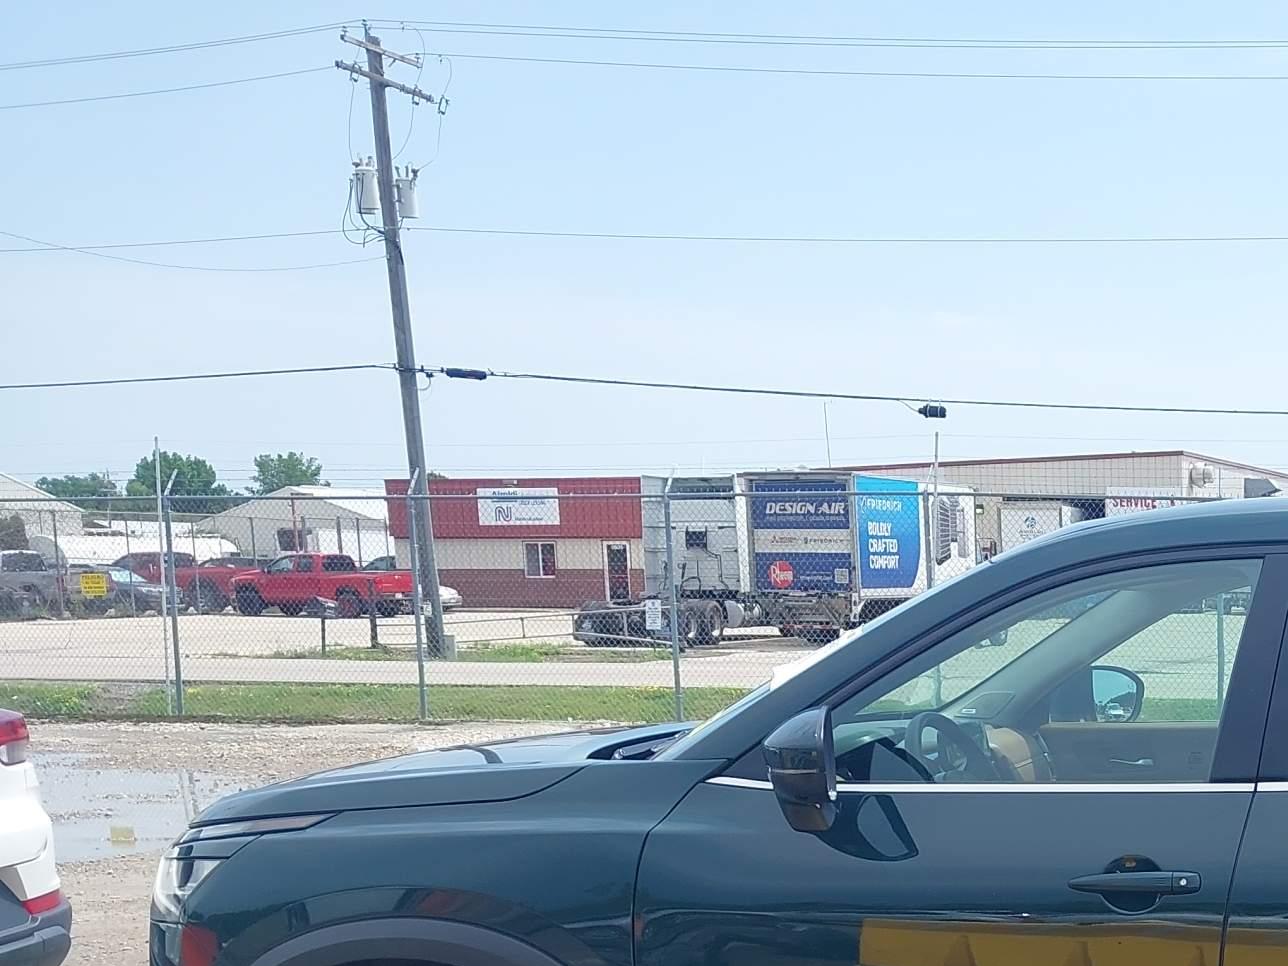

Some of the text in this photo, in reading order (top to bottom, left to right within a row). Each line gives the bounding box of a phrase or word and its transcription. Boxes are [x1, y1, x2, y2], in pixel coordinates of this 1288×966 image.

[765, 502, 845, 514] DESIGN AIR
[1112, 496, 1157, 509] SERVICE
[867, 521, 892, 536] BOLDLY
[868, 538, 898, 553] CRAFTED
[869, 555, 900, 569] COMFORT
